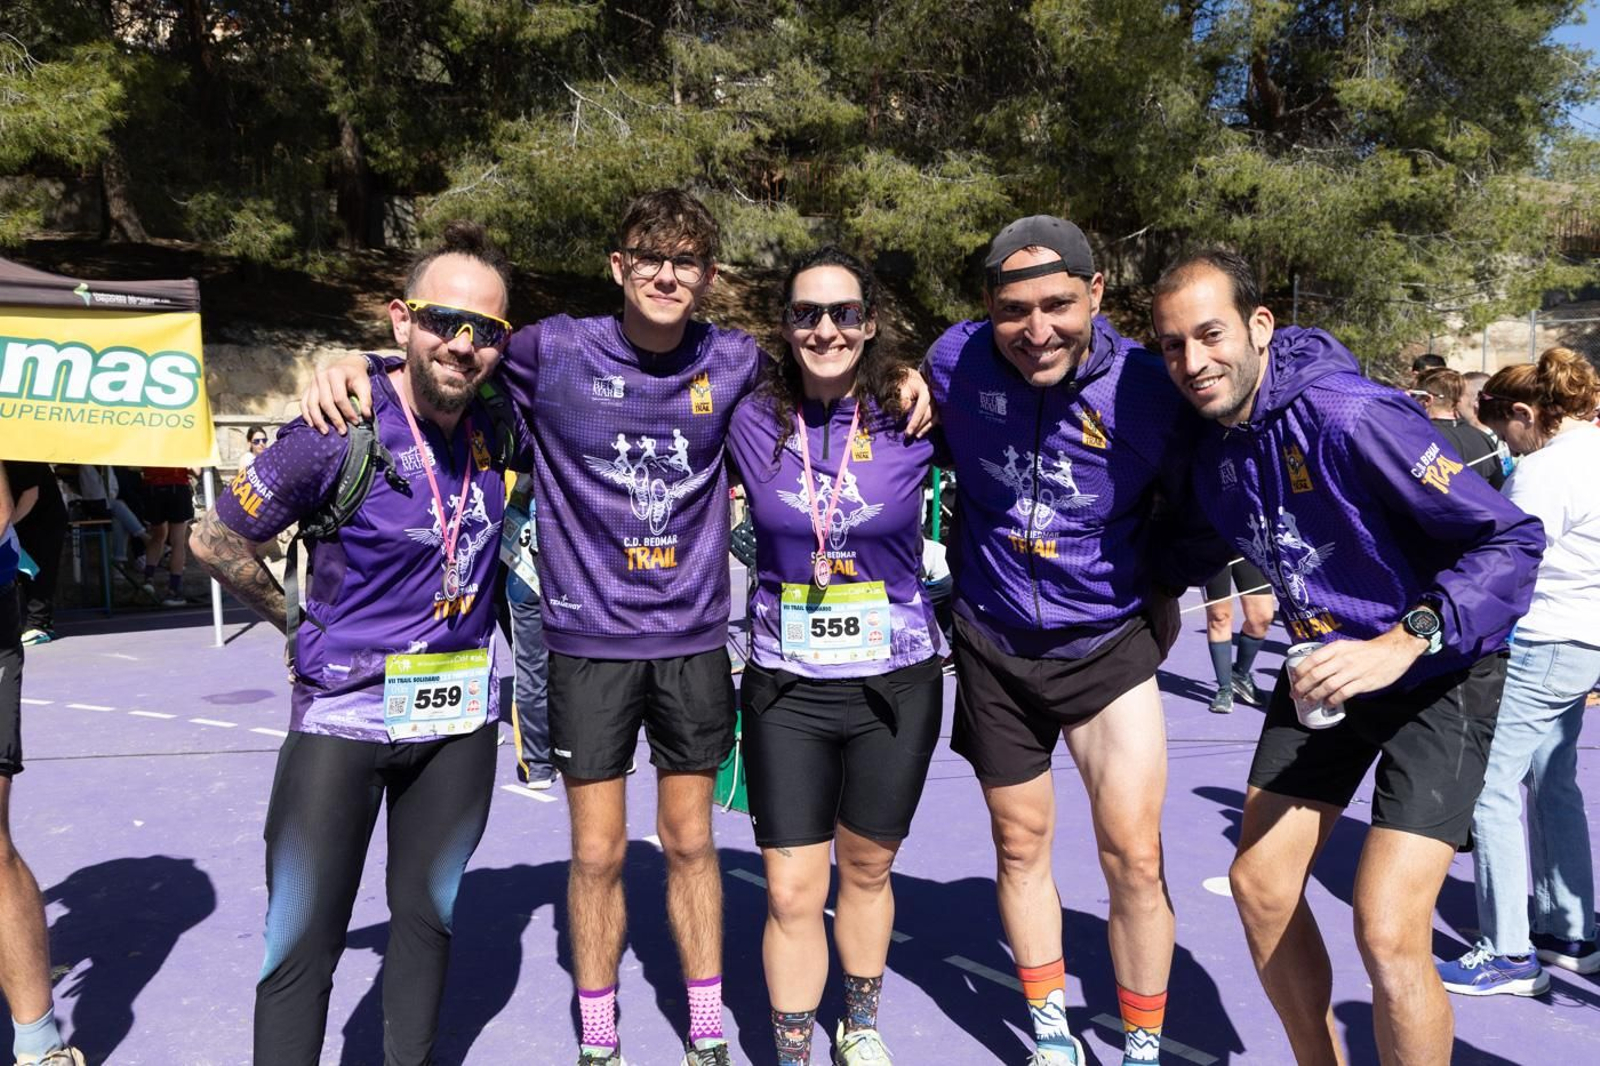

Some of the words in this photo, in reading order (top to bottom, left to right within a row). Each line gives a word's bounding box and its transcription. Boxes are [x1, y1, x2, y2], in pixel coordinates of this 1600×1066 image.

[0, 340, 198, 407] mas
[232, 469, 263, 518] RAIL
[624, 537, 641, 547] C.D.
[644, 534, 678, 547] BEDMAR
[624, 546, 677, 571] TRAIL
[827, 551, 857, 559] BEDMAR
[811, 616, 860, 638] 558
[413, 675, 440, 683] SOLIDARIO
[414, 685, 462, 710] 559
